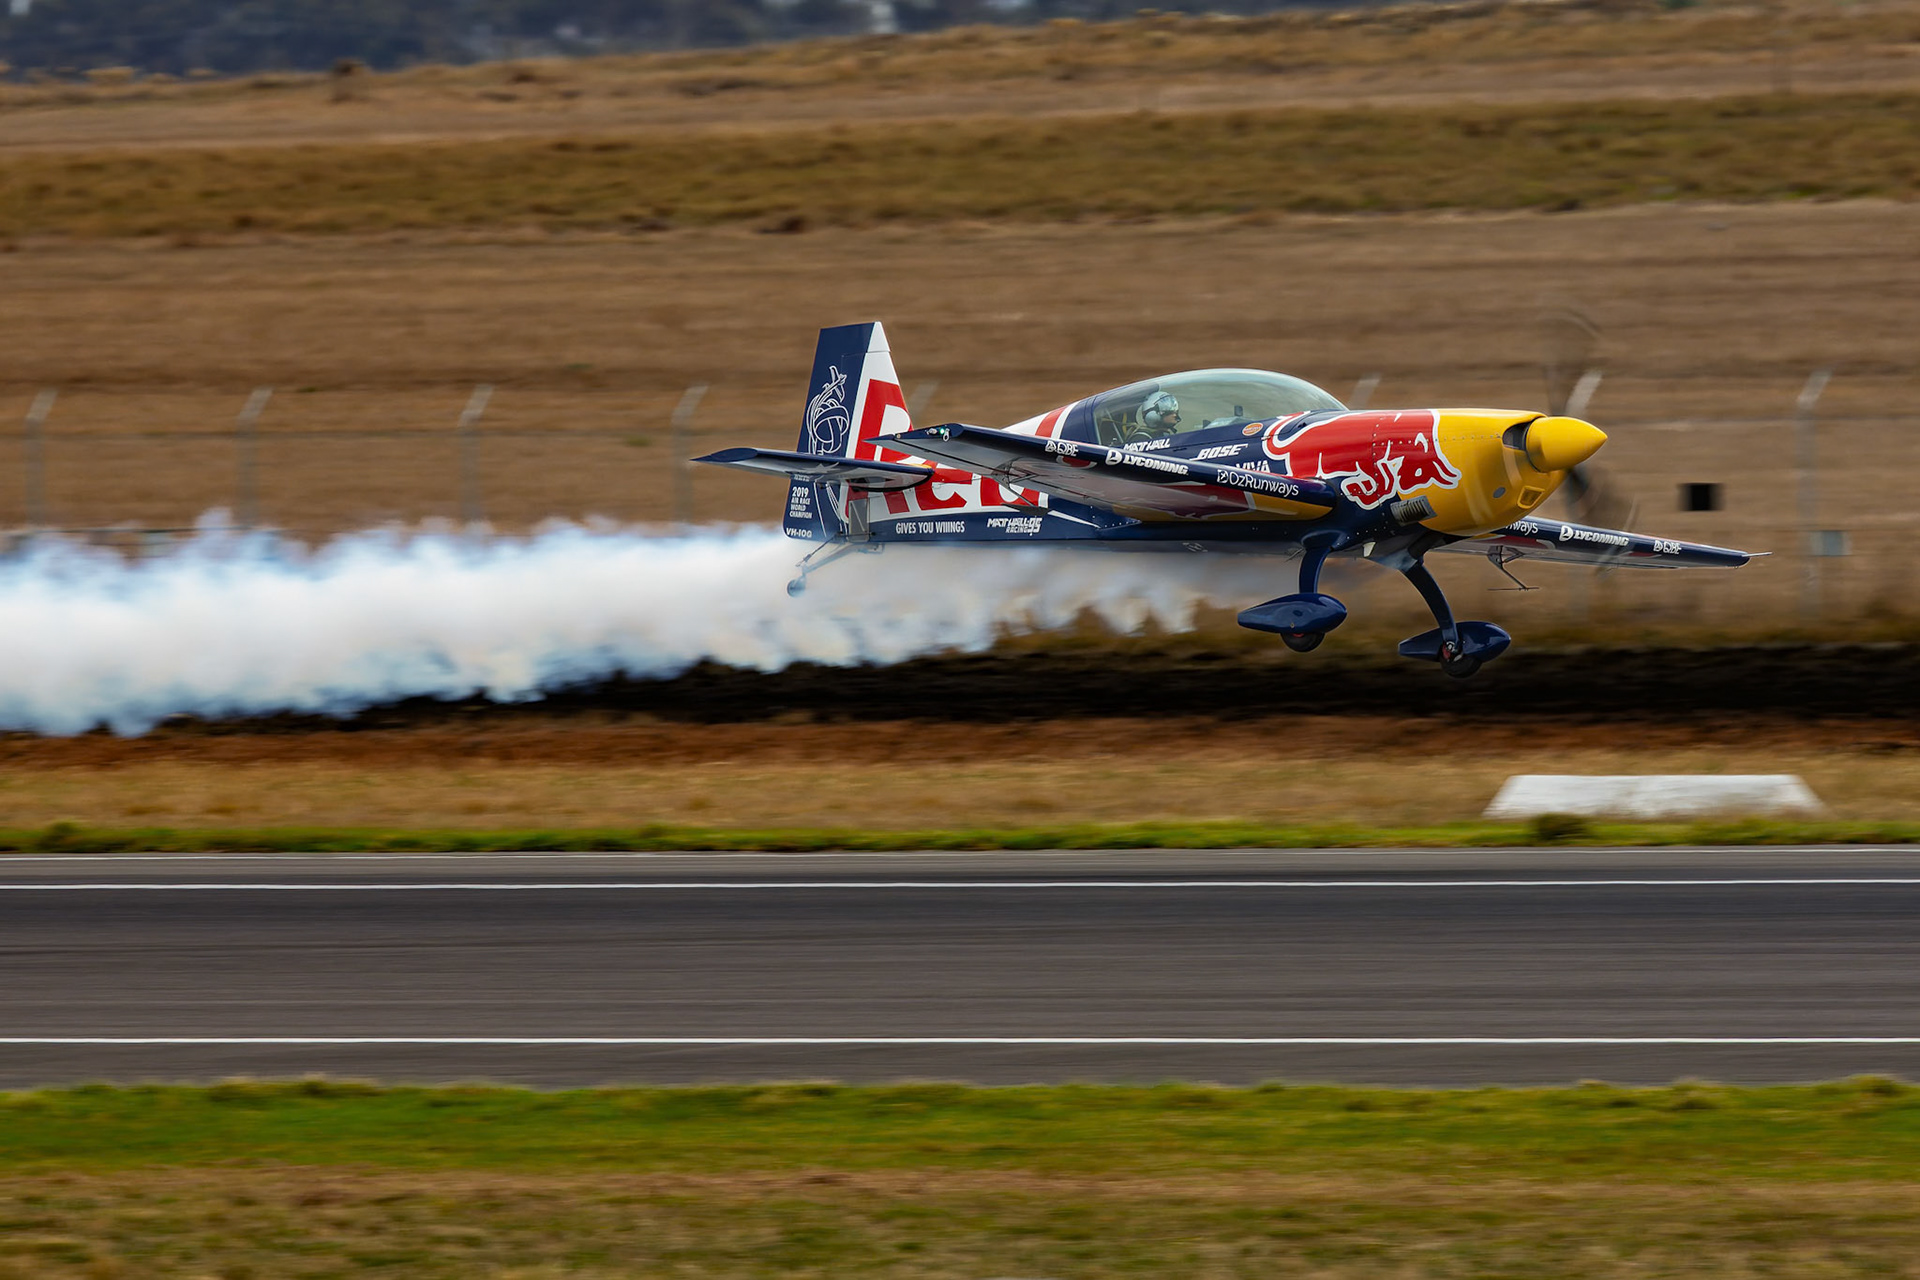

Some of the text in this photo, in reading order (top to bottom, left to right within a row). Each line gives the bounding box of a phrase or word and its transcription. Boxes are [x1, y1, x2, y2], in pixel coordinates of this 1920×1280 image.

[1057, 442, 1078, 457] QBE
[1146, 438, 1170, 451] HALL
[1190, 443, 1248, 461] BOSE
[1123, 455, 1189, 475] LYCOMING
[1229, 471, 1299, 497] OzRunways
[792, 486, 809, 498] 2019
[789, 511, 813, 519] CHAMPION
[790, 504, 806, 512] WORLD
[895, 521, 965, 535] GIVES YOU WIIINGS
[1573, 530, 1630, 547] LYCOMING
